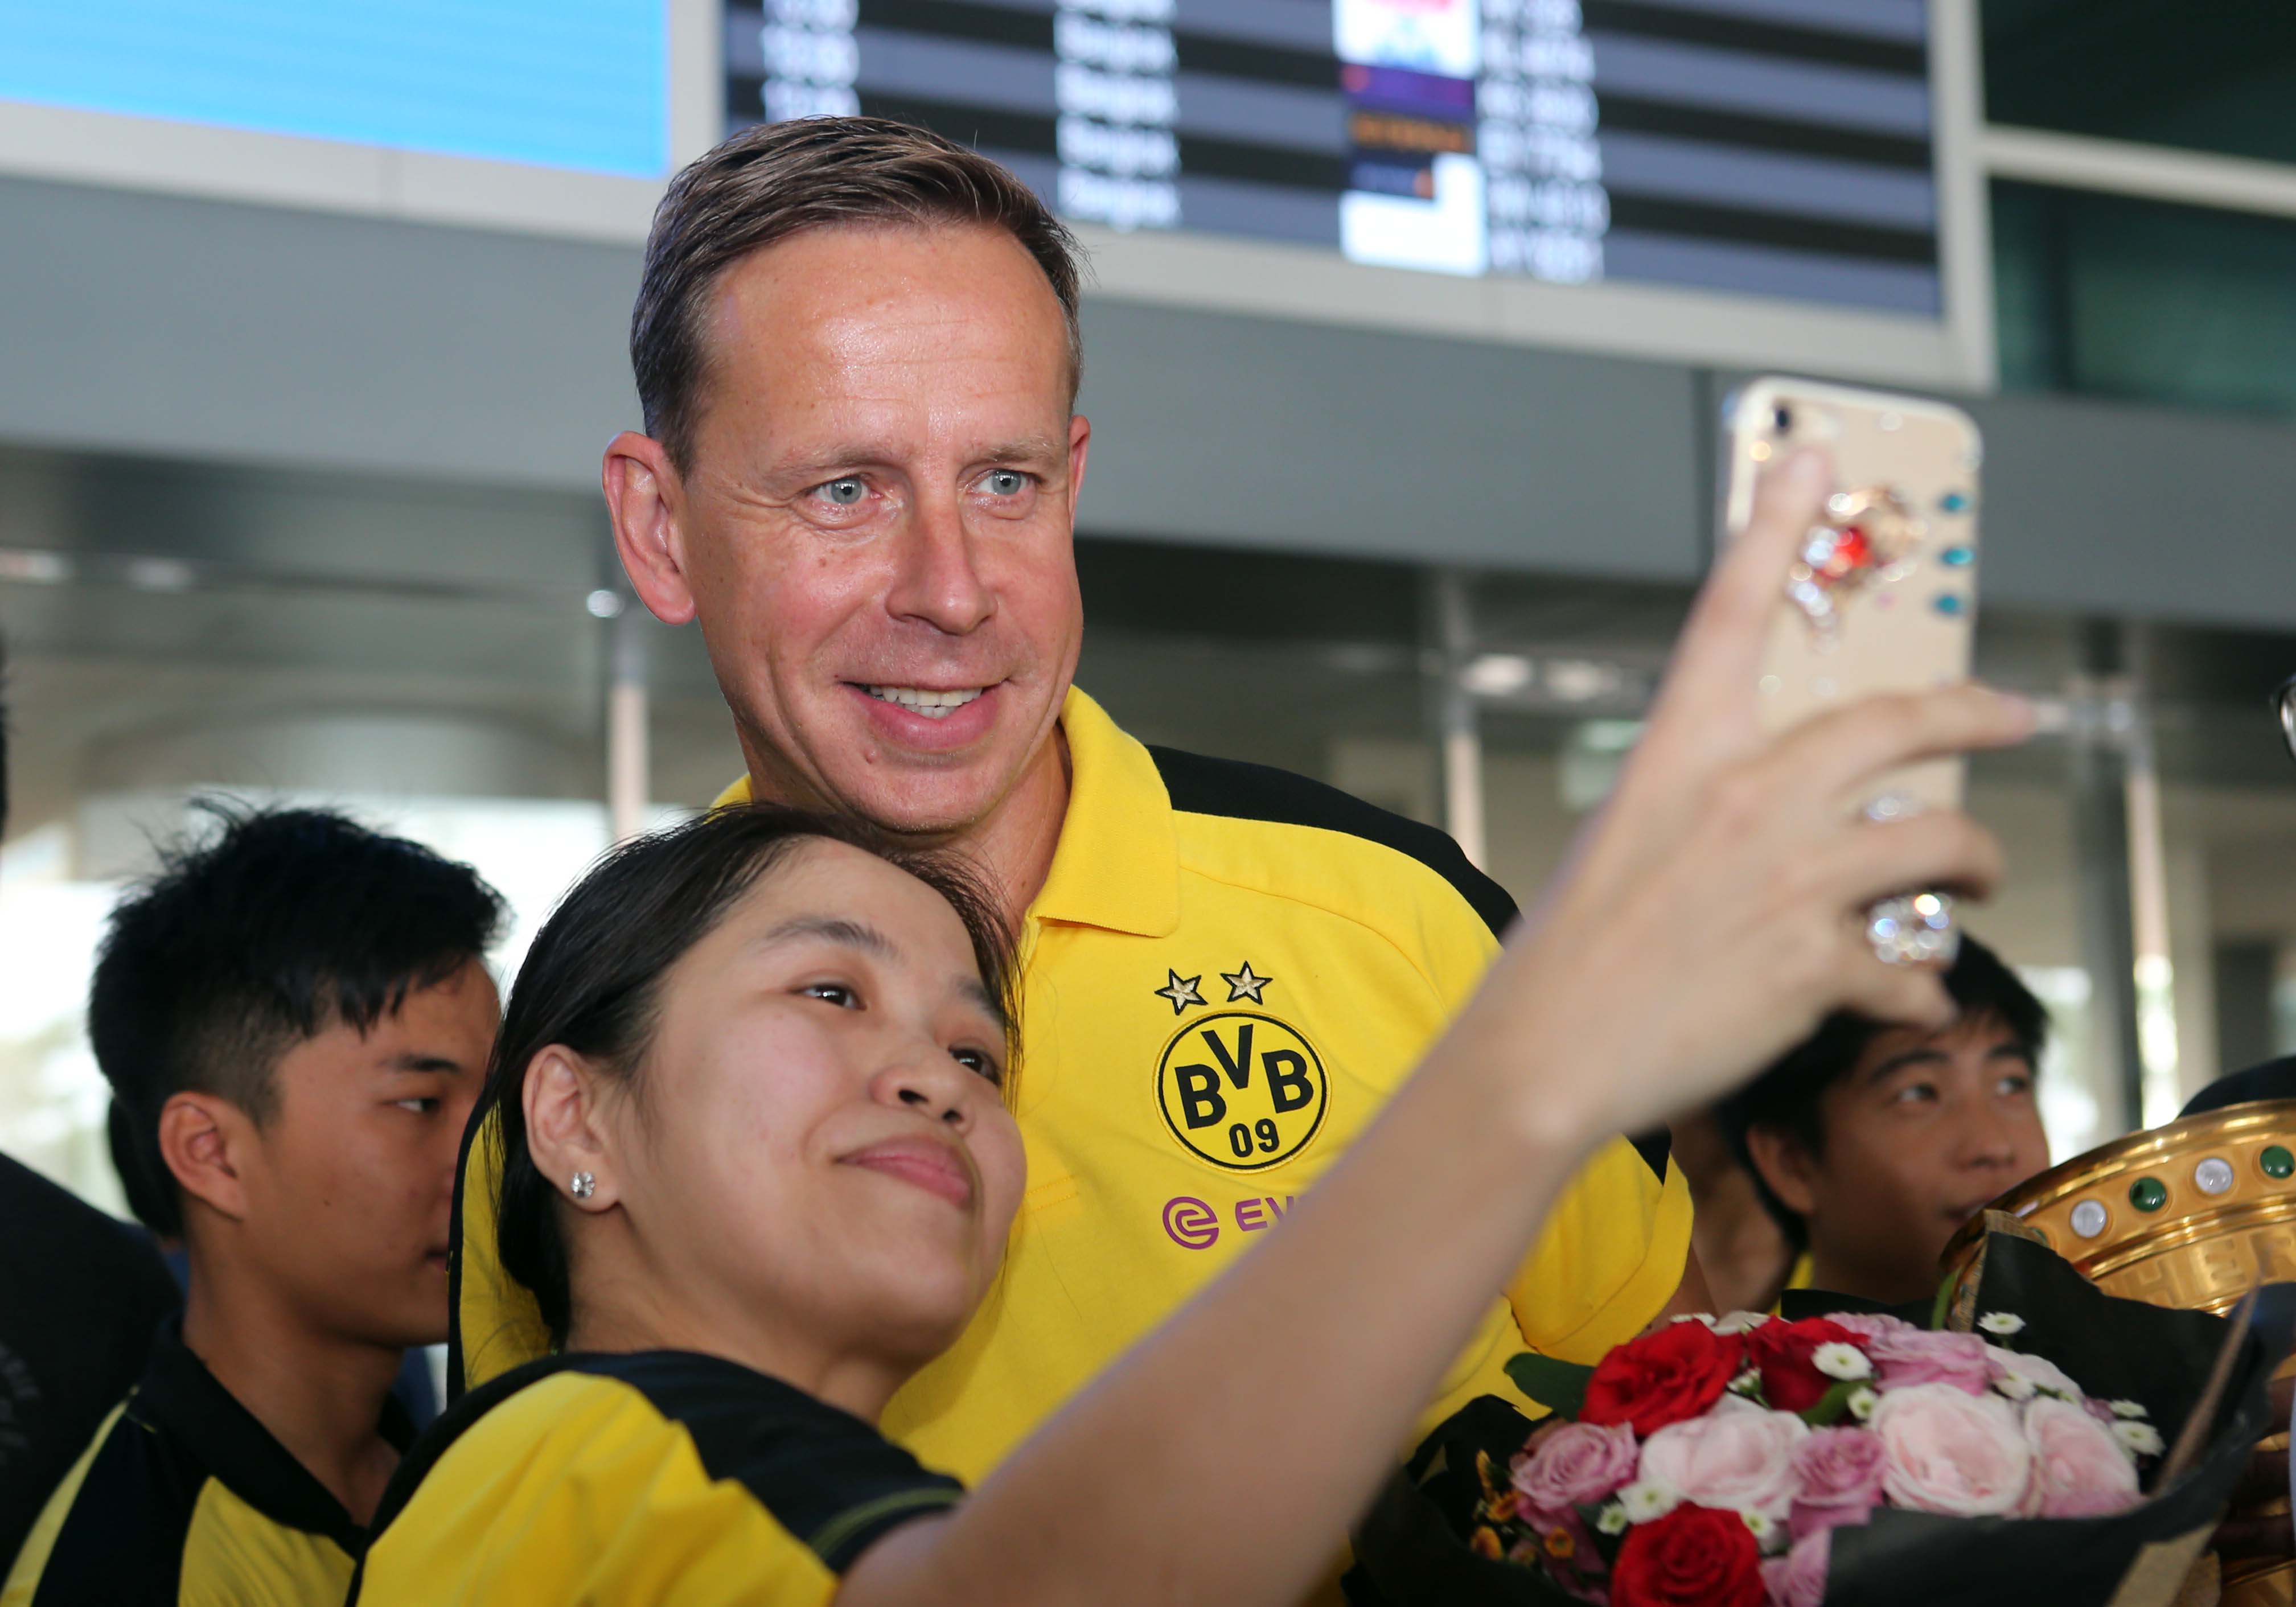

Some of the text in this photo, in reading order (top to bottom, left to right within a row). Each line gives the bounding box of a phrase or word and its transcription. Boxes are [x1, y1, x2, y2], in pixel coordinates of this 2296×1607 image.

[1174, 1024, 1315, 1130] BVB
[1229, 1117, 1280, 1158] 09
[1235, 1195, 1295, 1231] EV
[2103, 1228, 2296, 1306] HER
